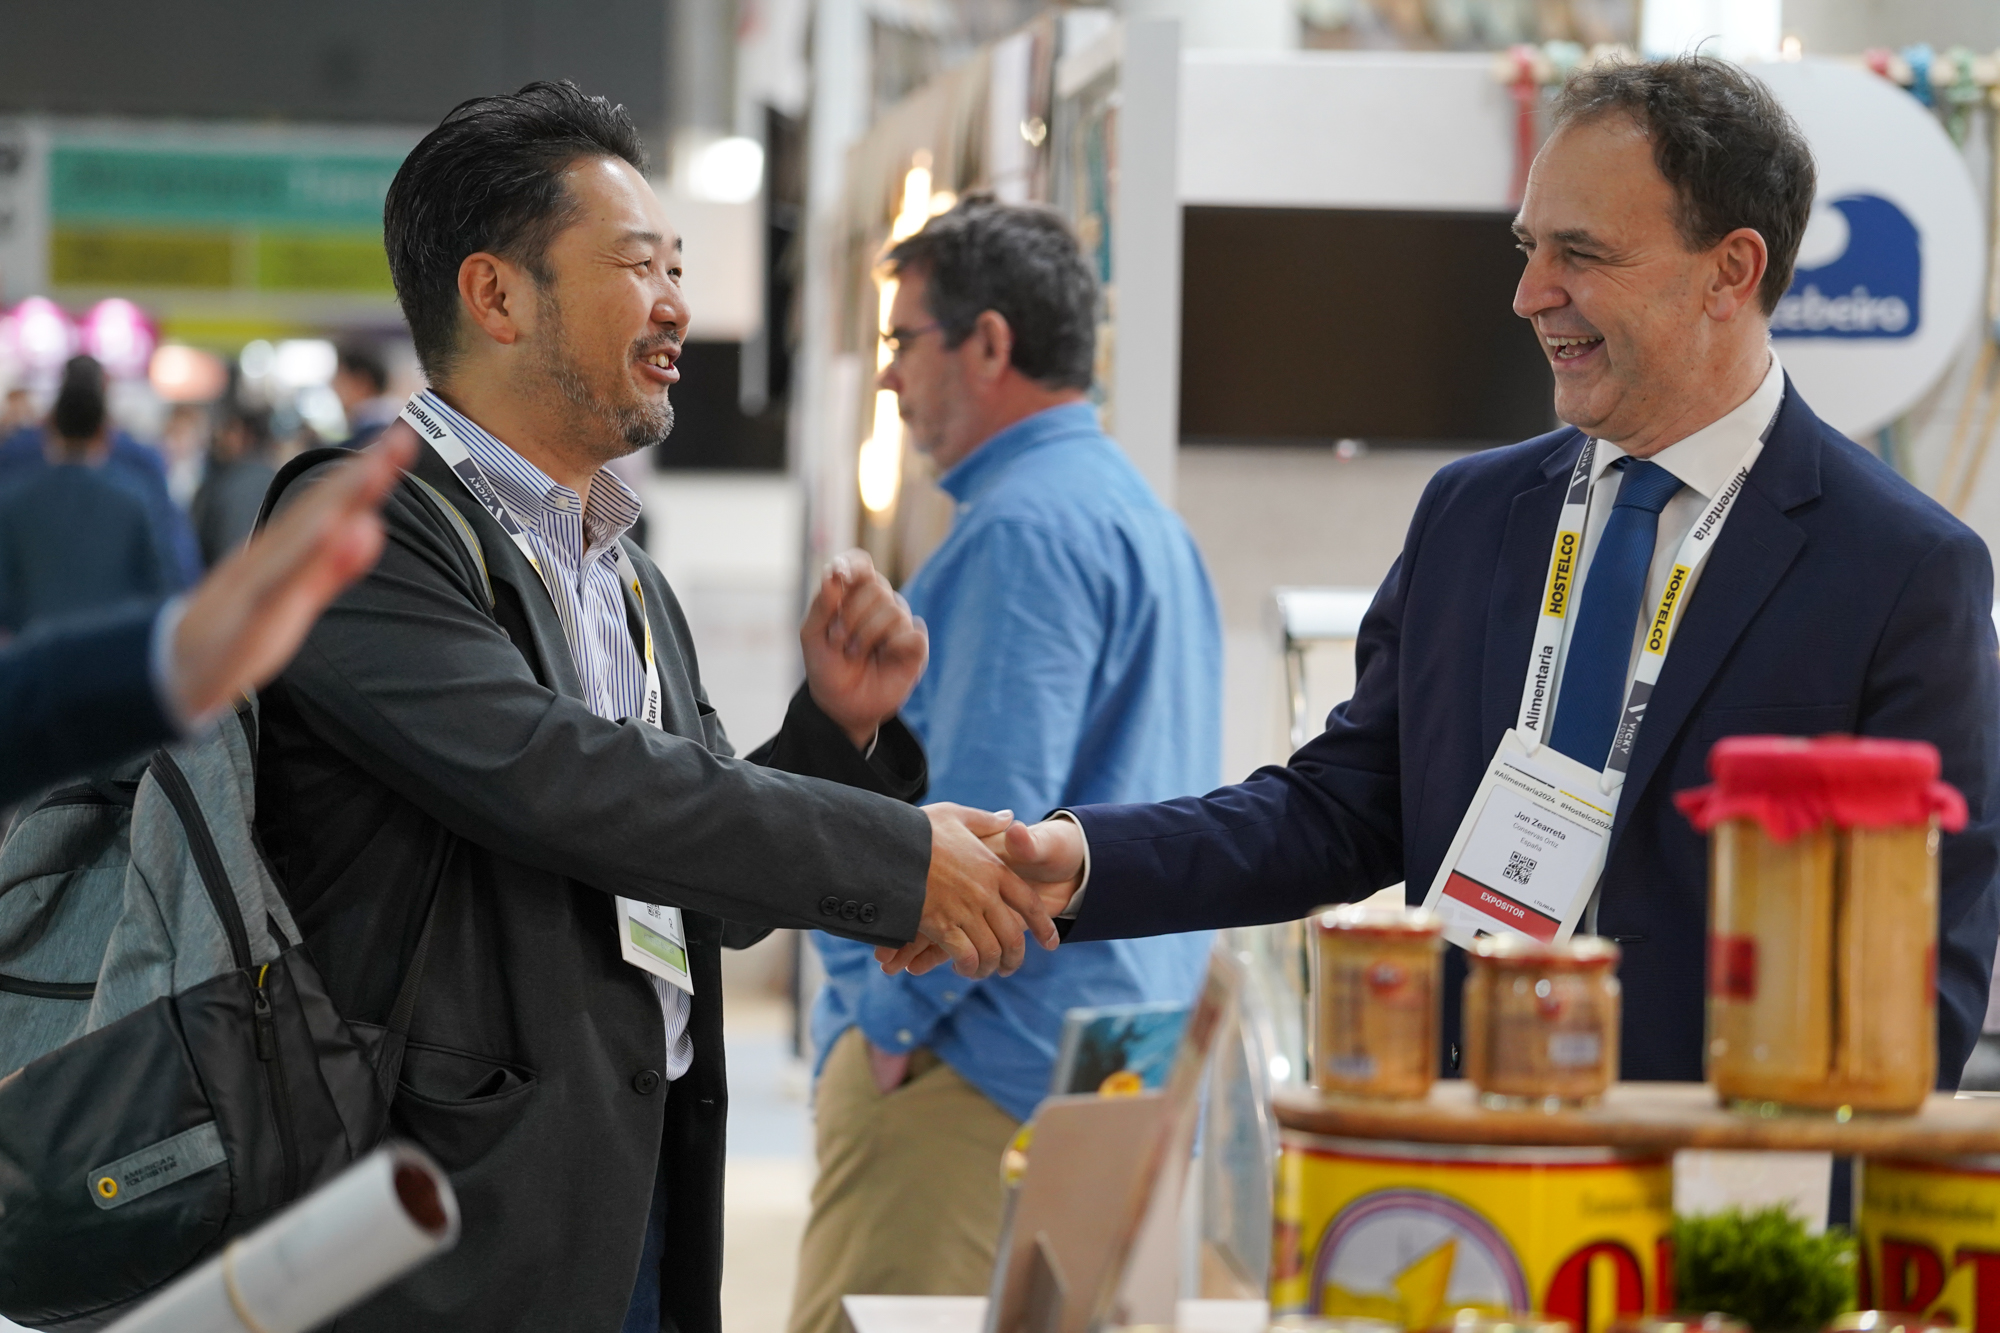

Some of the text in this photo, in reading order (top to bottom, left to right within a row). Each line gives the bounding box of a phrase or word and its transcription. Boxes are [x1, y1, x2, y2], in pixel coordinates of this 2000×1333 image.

[405, 400, 447, 440] Alimenta
[468, 476, 492, 503] VICKY
[1693, 466, 1749, 541] Alimentaria
[1549, 533, 1575, 614] HOSTELCO
[1650, 568, 1685, 651] HOSTELCO
[1525, 645, 1554, 731] Alimentaria
[1615, 722, 1628, 749] FOODS
[1621, 722, 1637, 755] VICKY
[1493, 769, 1556, 804] #Alimentaria2024
[1512, 822, 1560, 849] Conservas Ortiz
[1514, 811, 1567, 841] Jon Zearreta
[1519, 836, 1543, 852] España
[1480, 891, 1525, 919] EXPOSITOR
[124, 1155, 175, 1180] AMERICAN
[126, 1161, 177, 1187] TOURISTER
